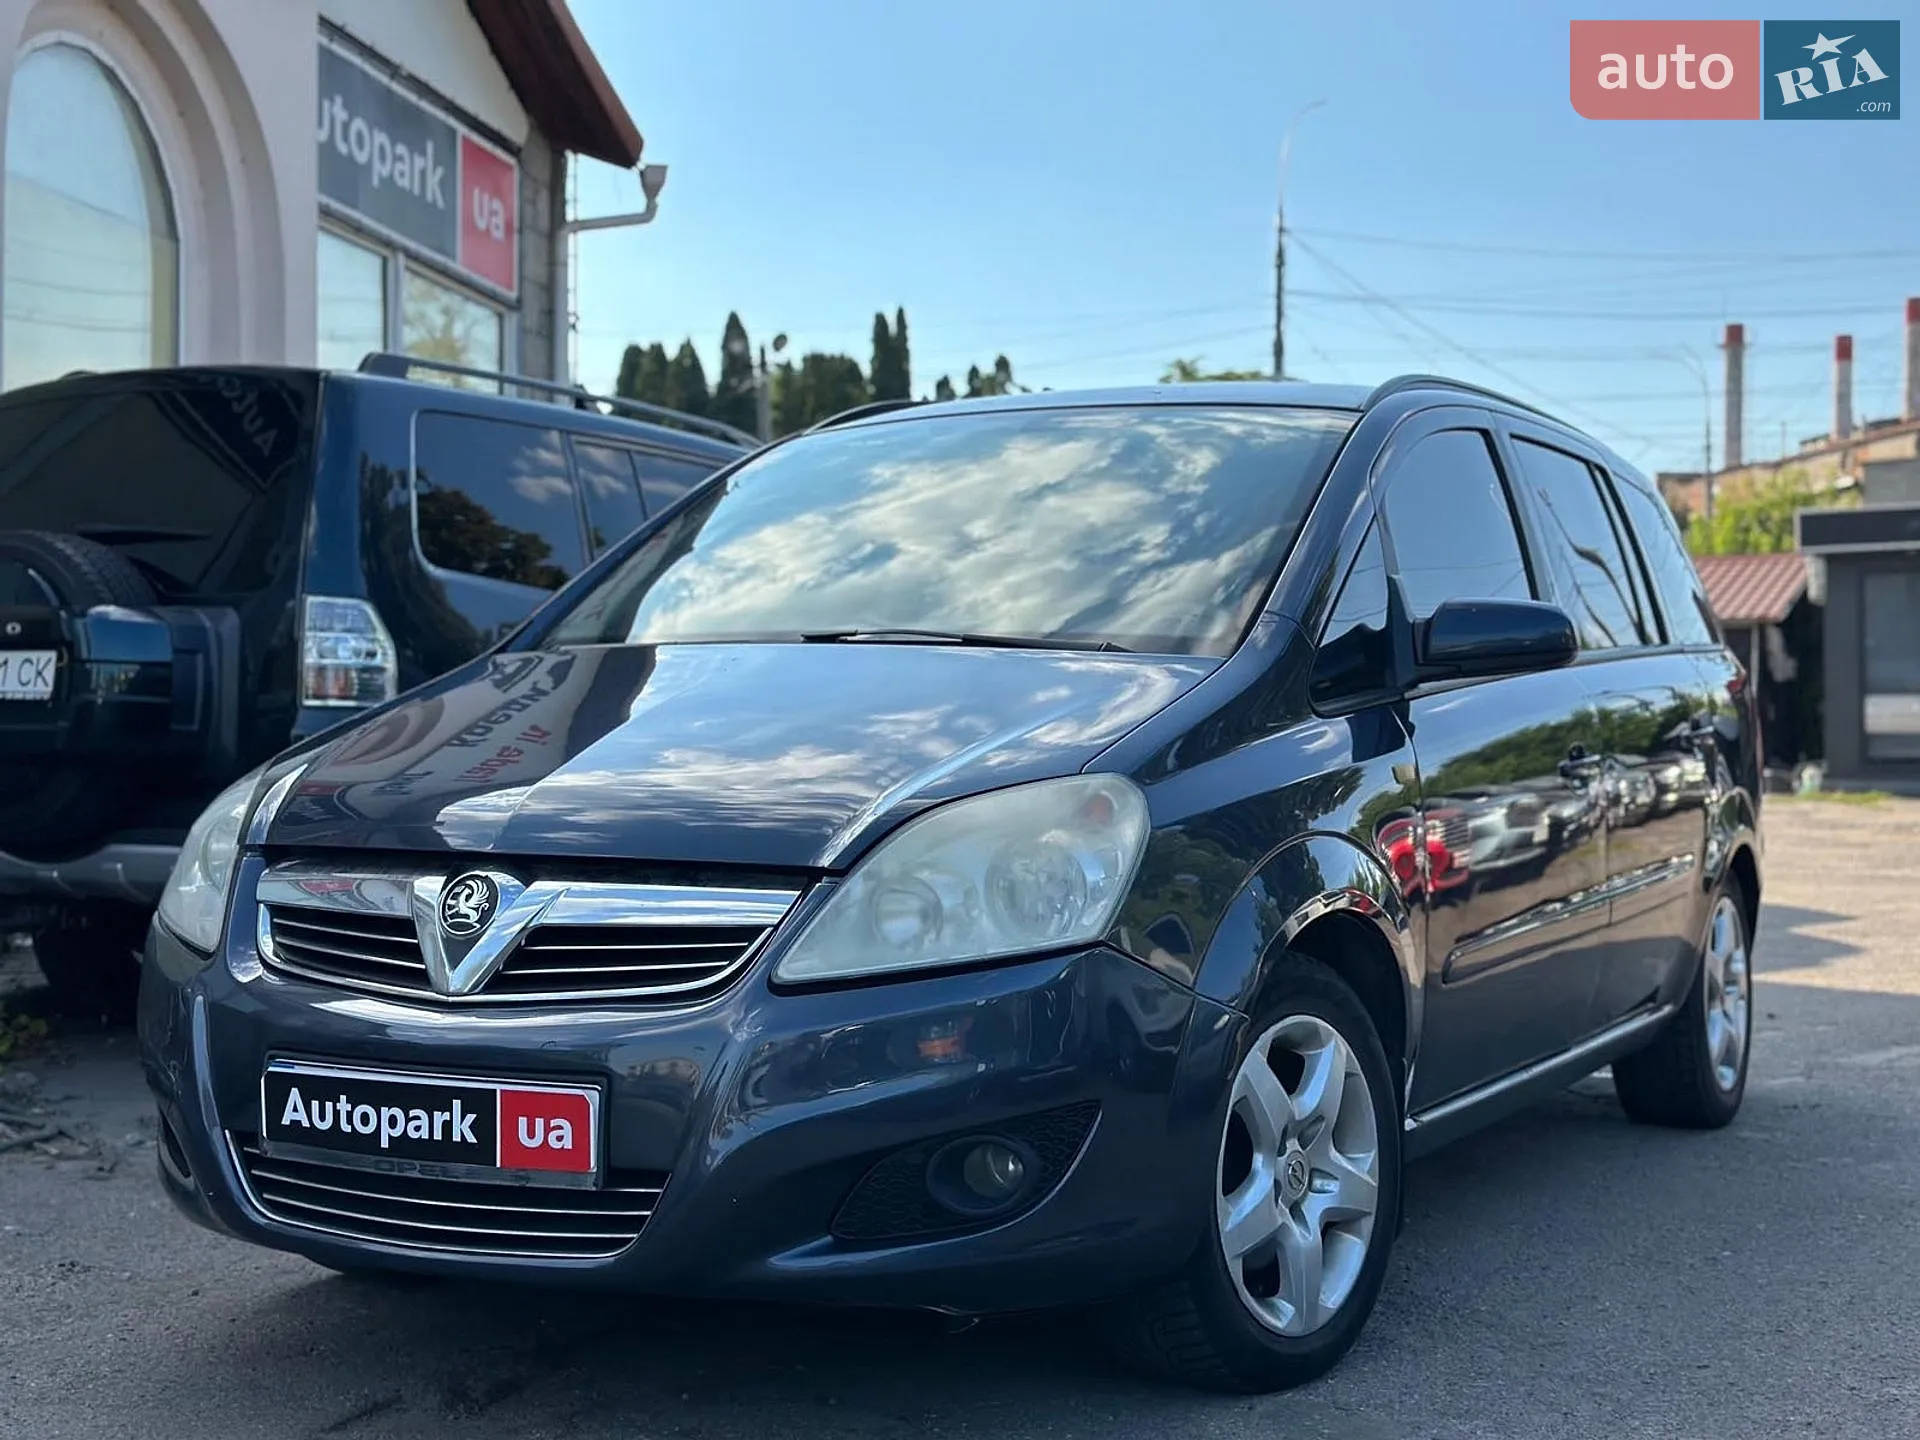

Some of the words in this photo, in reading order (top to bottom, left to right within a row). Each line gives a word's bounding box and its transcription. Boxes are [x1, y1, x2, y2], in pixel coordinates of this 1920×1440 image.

[317, 94, 445, 210] utopark
[472, 186, 506, 241] ua
[281, 1087, 478, 1148] Autopark
[518, 1115, 574, 1150] ua
